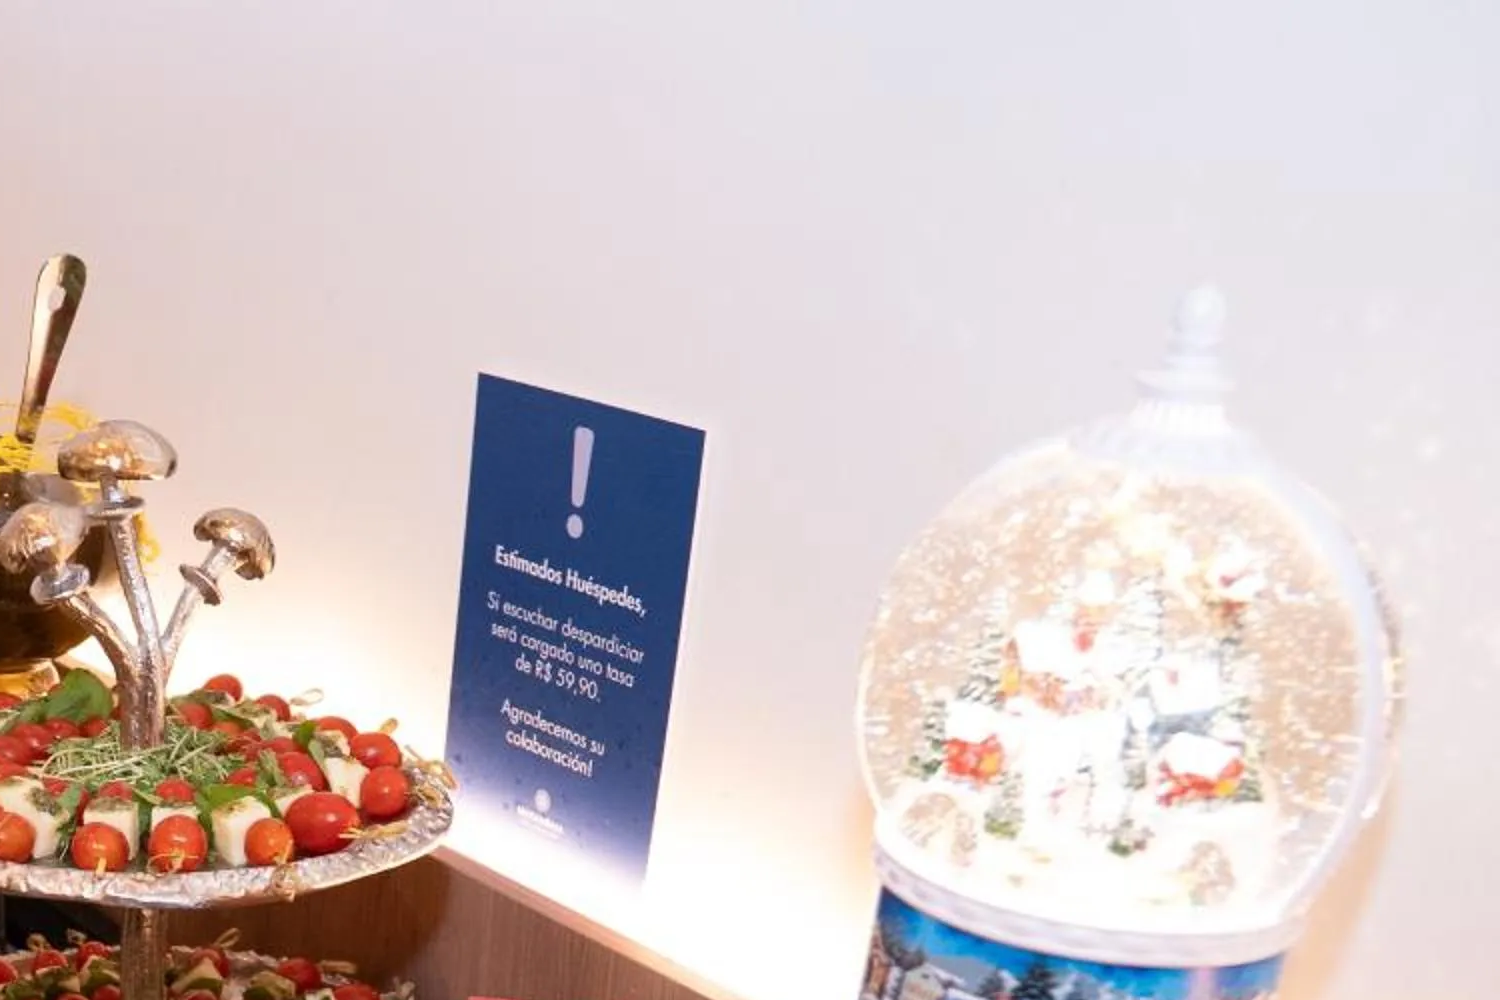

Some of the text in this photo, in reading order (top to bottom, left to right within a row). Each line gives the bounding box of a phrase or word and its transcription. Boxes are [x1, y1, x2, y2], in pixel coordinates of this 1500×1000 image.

[495, 544, 646, 617] Estimados Huéspedes,
[487, 591, 500, 610] Si
[502, 602, 558, 632] escuchar
[491, 622, 517, 643] será
[605, 662, 635, 688] tasa
[515, 652, 531, 673] de
[534, 659, 553, 683] R$
[500, 698, 605, 755] Agradecemos su
[505, 730, 593, 778] colaboración!
